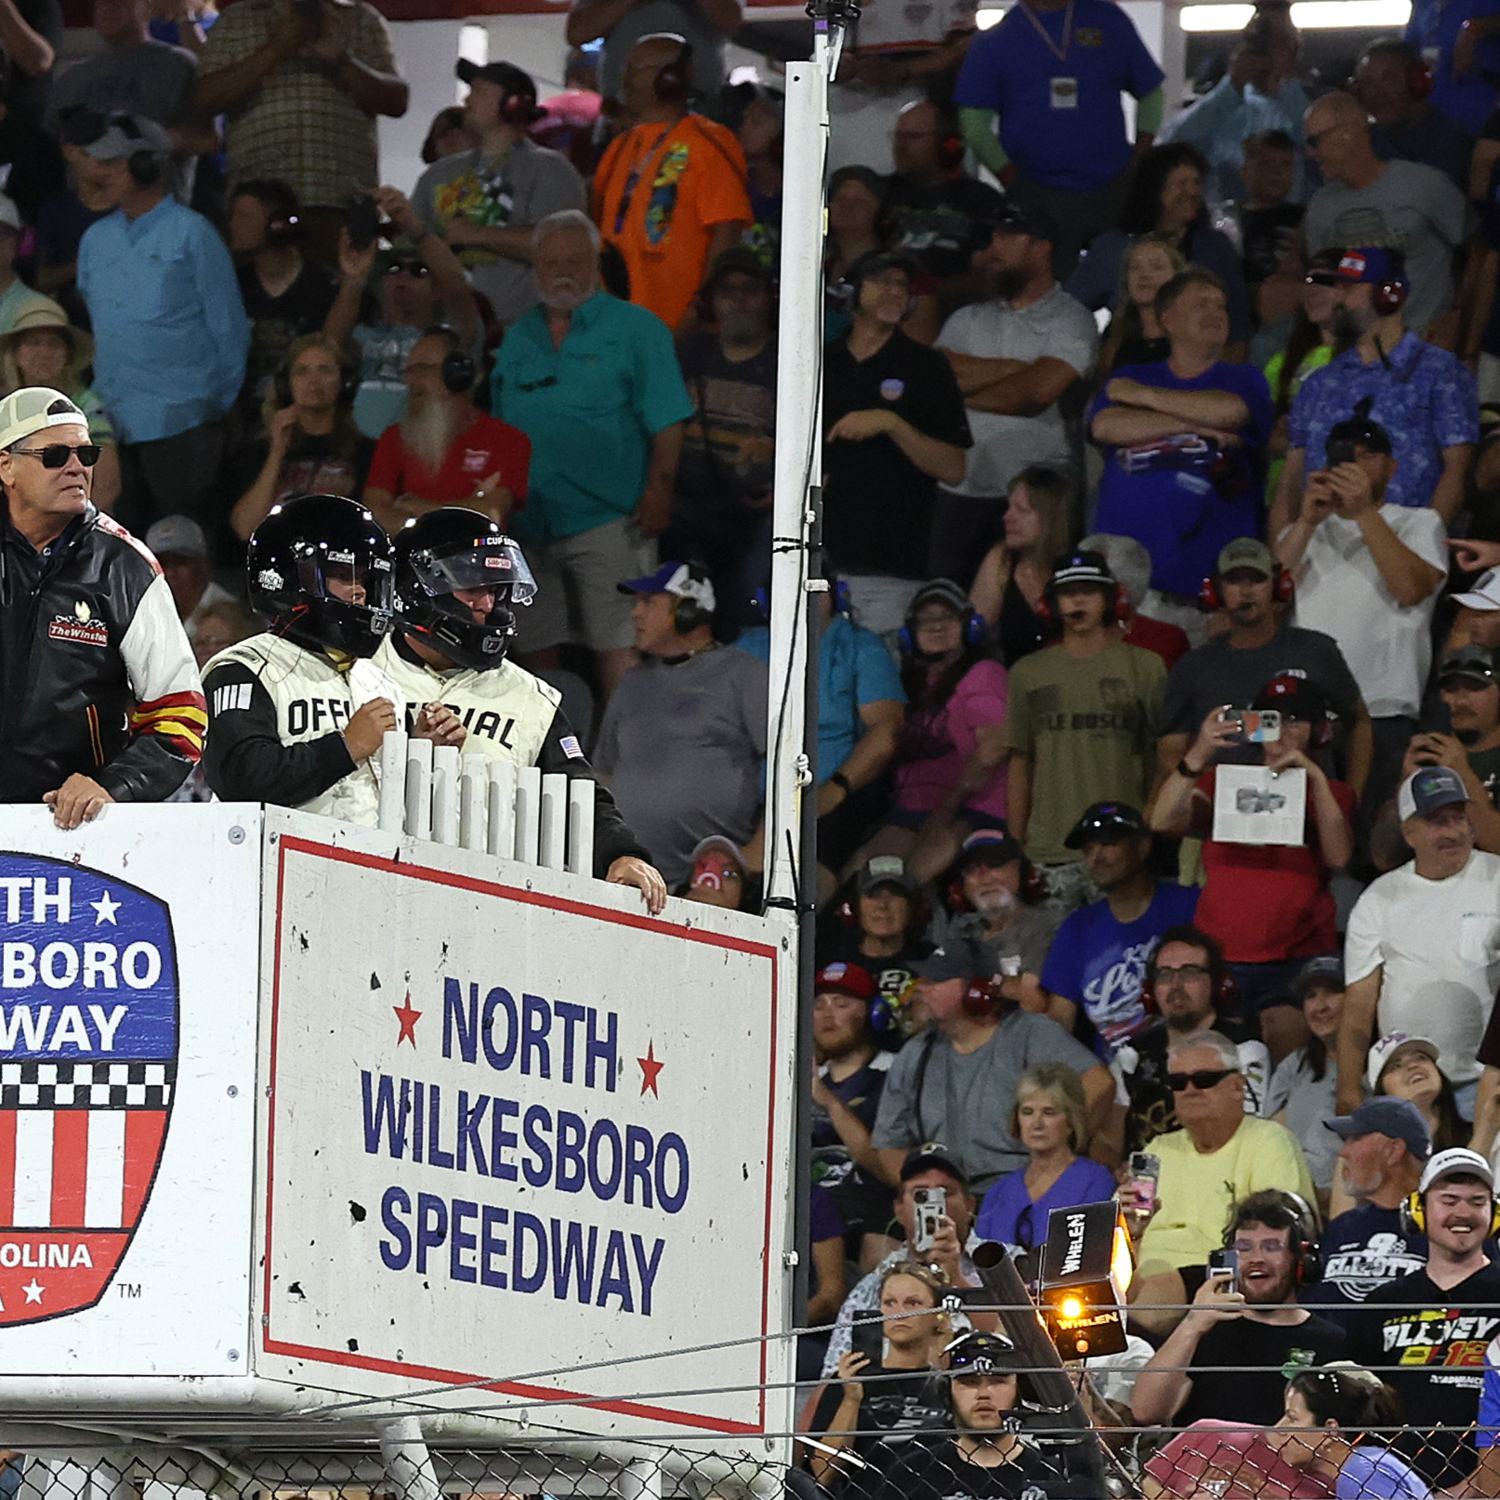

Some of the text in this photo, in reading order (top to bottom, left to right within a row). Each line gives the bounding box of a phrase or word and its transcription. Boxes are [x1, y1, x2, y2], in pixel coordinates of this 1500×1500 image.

[442, 977, 619, 1093] NORTH
[361, 1070, 690, 1214] WILKESBORO
[379, 1186, 665, 1317] SPEEDWAY
[1060, 1213, 1087, 1277] WHELEN
[117, 1284, 141, 1298] TM
[1056, 1311, 1118, 1330] WHELEN
